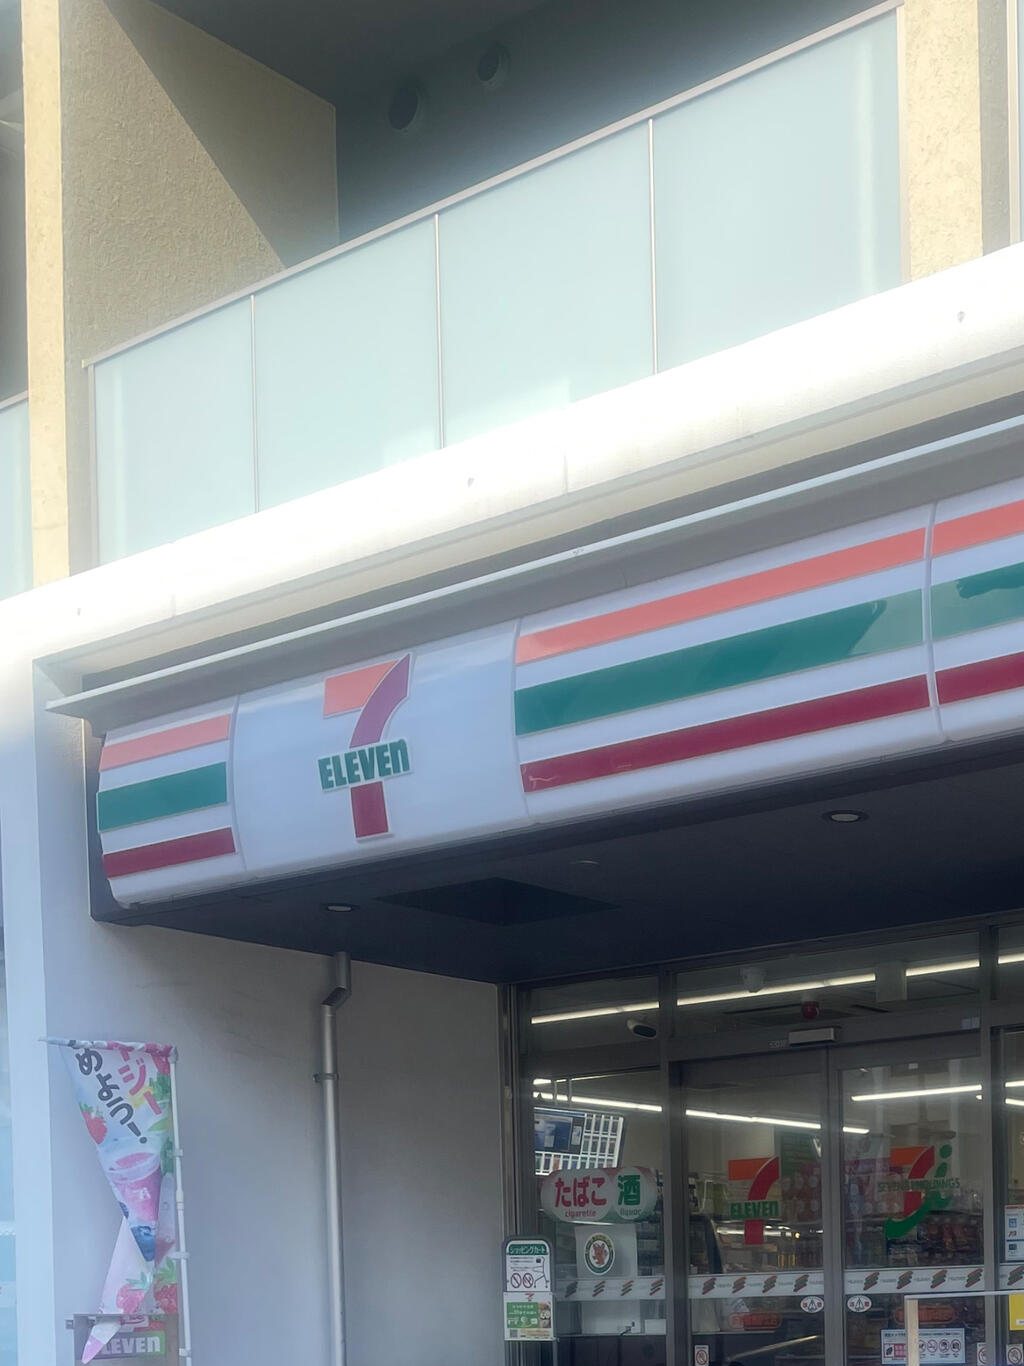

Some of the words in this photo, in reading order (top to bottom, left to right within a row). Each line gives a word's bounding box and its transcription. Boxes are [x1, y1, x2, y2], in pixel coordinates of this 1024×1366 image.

[555, 1175, 607, 1208] たばこ
[618, 1174, 641, 1206] 酒
[564, 1209, 597, 1218] cigarette
